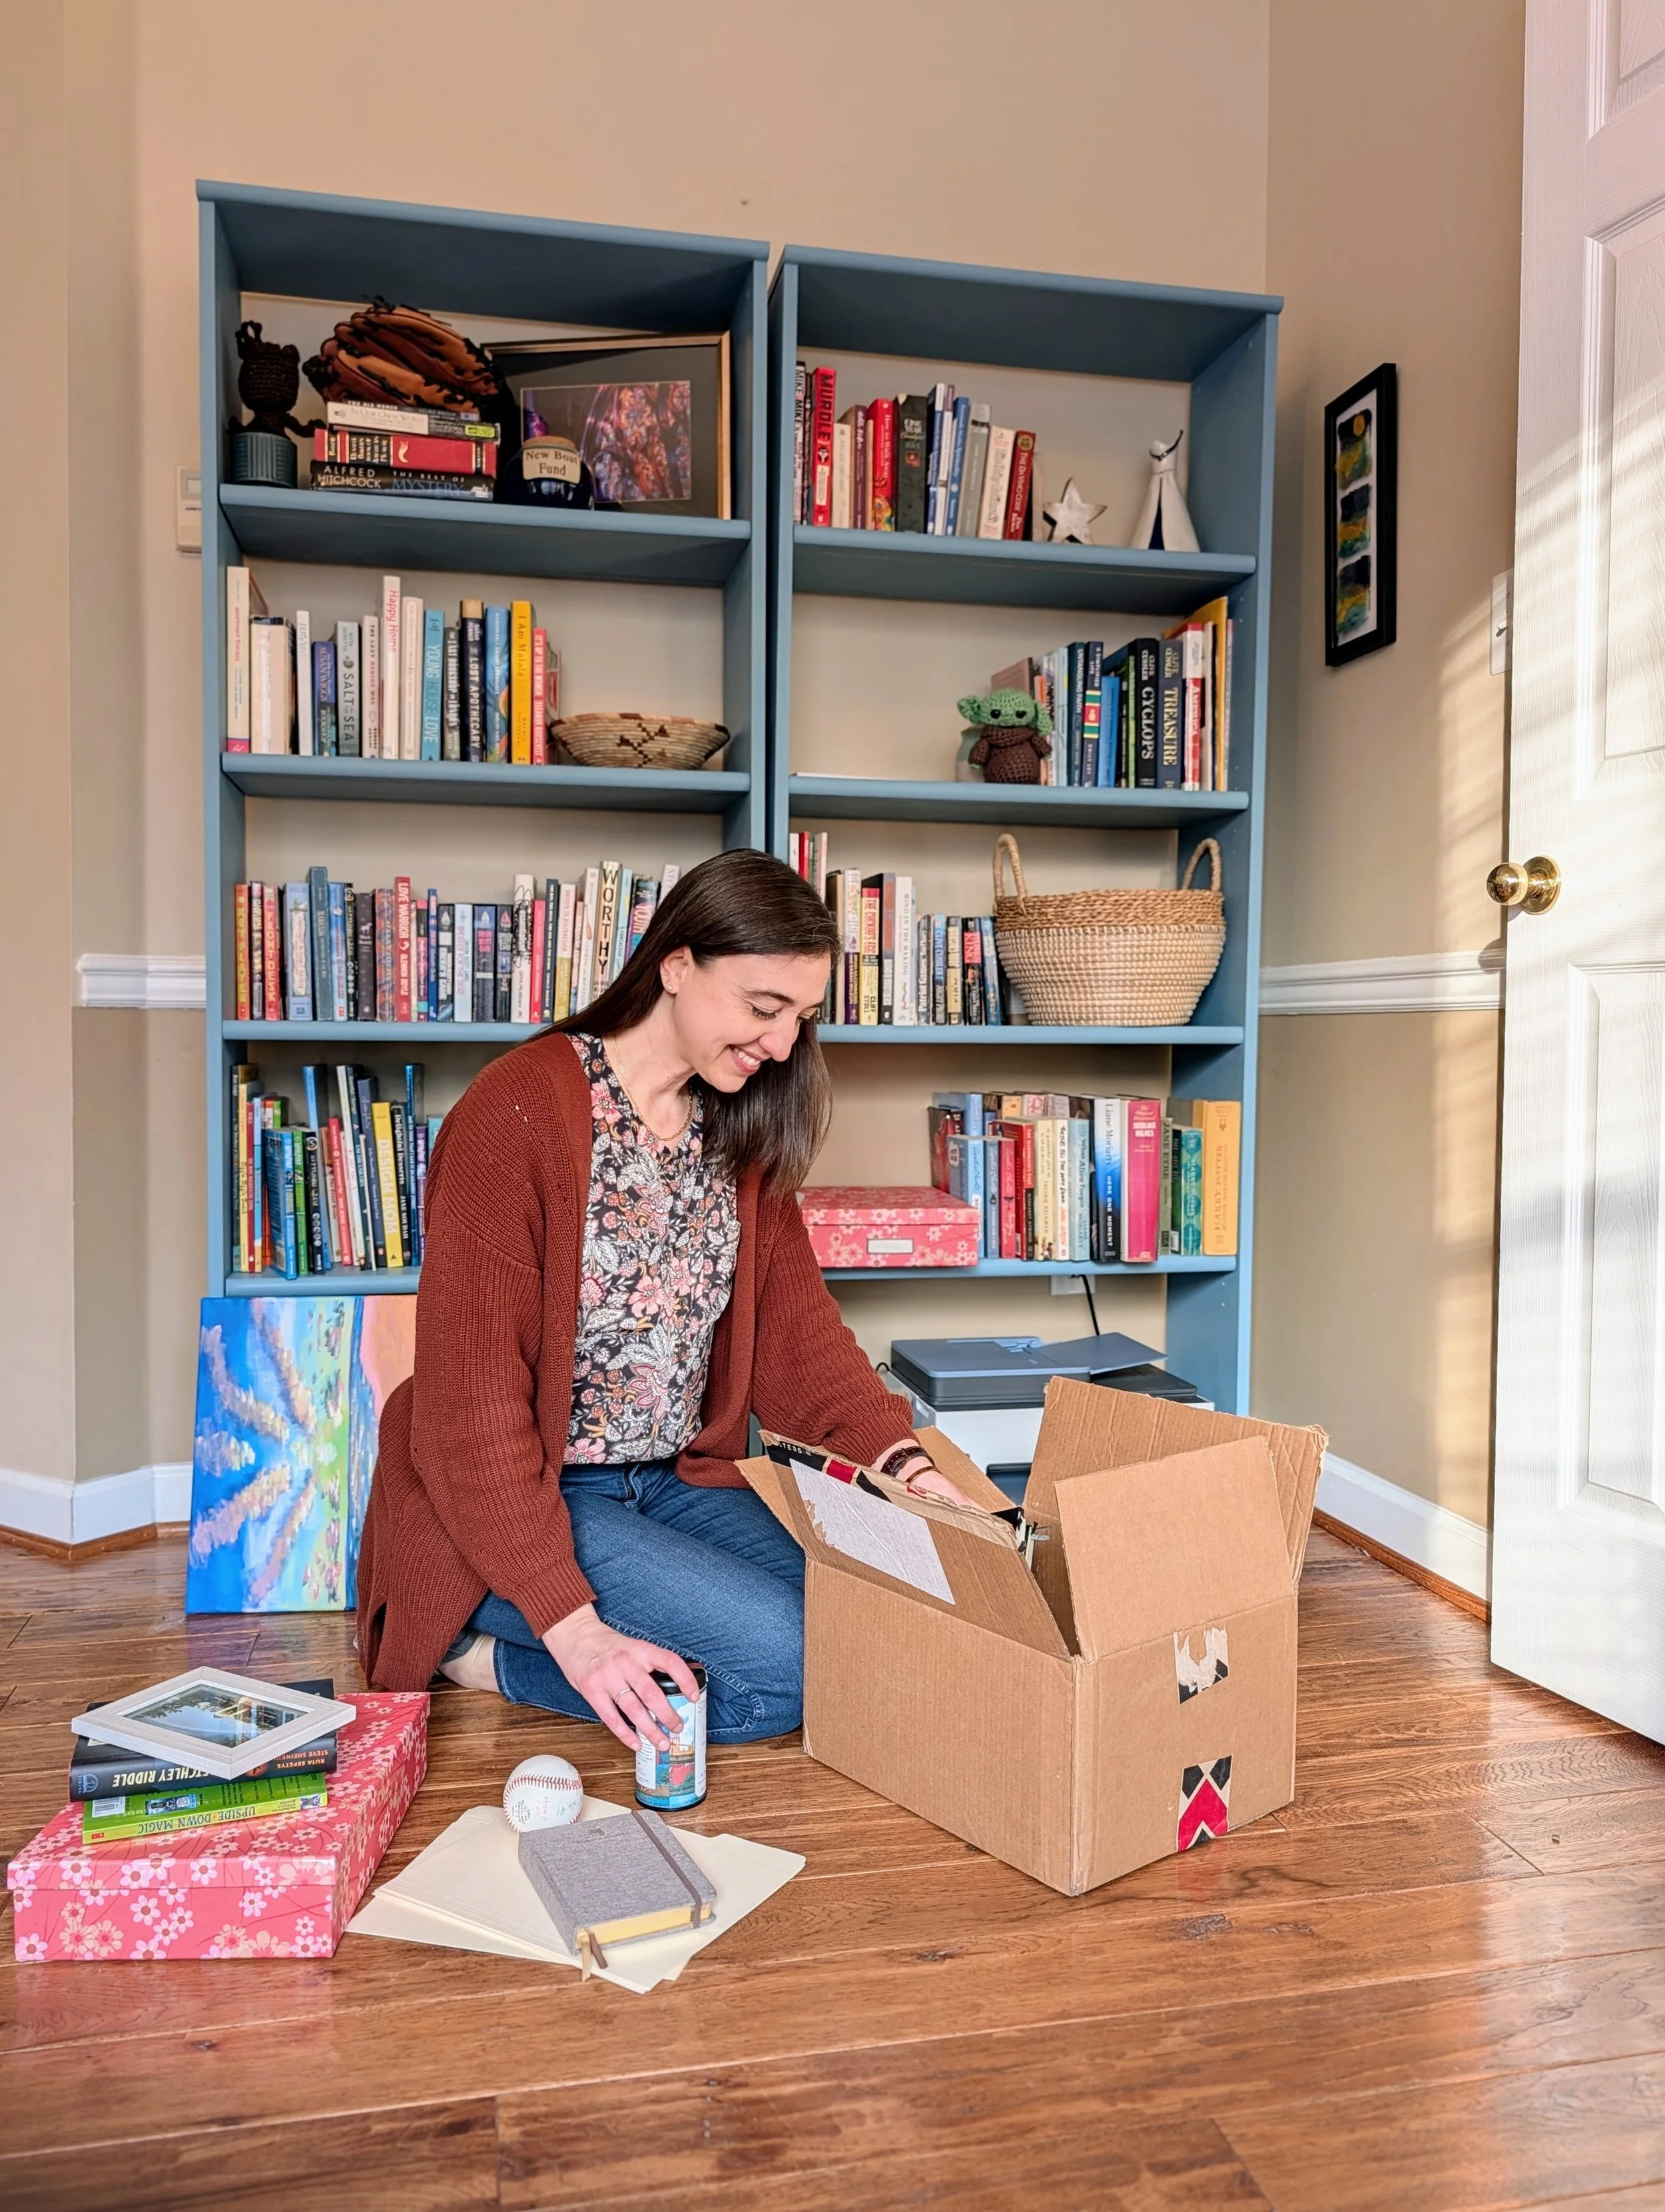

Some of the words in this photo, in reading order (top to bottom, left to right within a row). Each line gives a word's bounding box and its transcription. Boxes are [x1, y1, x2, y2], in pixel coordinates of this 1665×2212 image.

[819, 374, 832, 441] MURDLE
[526, 450, 549, 461] New
[554, 451, 578, 465] Boat
[539, 463, 566, 476] Fund
[1019, 452, 1028, 465] THE
[317, 474, 382, 490] HITCHCOCK
[324, 466, 376, 478] ALFRED
[392, 478, 464, 495] MYSTERY
[1014, 494, 1023, 511] CODE
[386, 590, 399, 621] Happy
[389, 625, 399, 653] Home
[517, 623, 527, 639] Am
[426, 644, 440, 678] YOUNG
[448, 641, 458, 657] LAST
[517, 644, 527, 677] Malala
[448, 658, 459, 693] BOOKSHOP
[470, 657, 479, 682] LOST
[344, 673, 354, 705] SALT
[426, 681, 439, 713] HOUSE
[344, 715, 354, 741] SEA
[425, 717, 438, 743] LOVE
[470, 686, 480, 748] APOTHECARY
[1142, 687, 1154, 759] CYCLOPS
[1164, 687, 1178, 765] TREASURE
[400, 883, 408, 903] LOVE
[865, 899, 876, 911] THE
[400, 904, 409, 938] WARRIOR
[599, 869, 619, 975] WORTHY
[864, 912, 876, 941] CUCKOO'S
[266, 911, 276, 958] FRONT
[866, 942, 876, 954] EGG
[267, 960, 276, 1002] DESK
[918, 985, 928, 1012] Patriot
[394, 1114, 404, 1152] Delightful
[1104, 1130, 1114, 1166] Moriarty
[377, 1139, 392, 1193] DESIGN
[382, 1196, 396, 1234] MOM
[277, 1760, 306, 1770] SEPETYS
[308, 1749, 328, 1758] STEVE
[112, 1771, 156, 1787] RIDDLE
[157, 1766, 212, 1782] ETCHLEY
[138, 1819, 173, 1834] MAGIC
[178, 1813, 212, 1828] DOWN
[218, 1806, 256, 1822] UPSIDE
